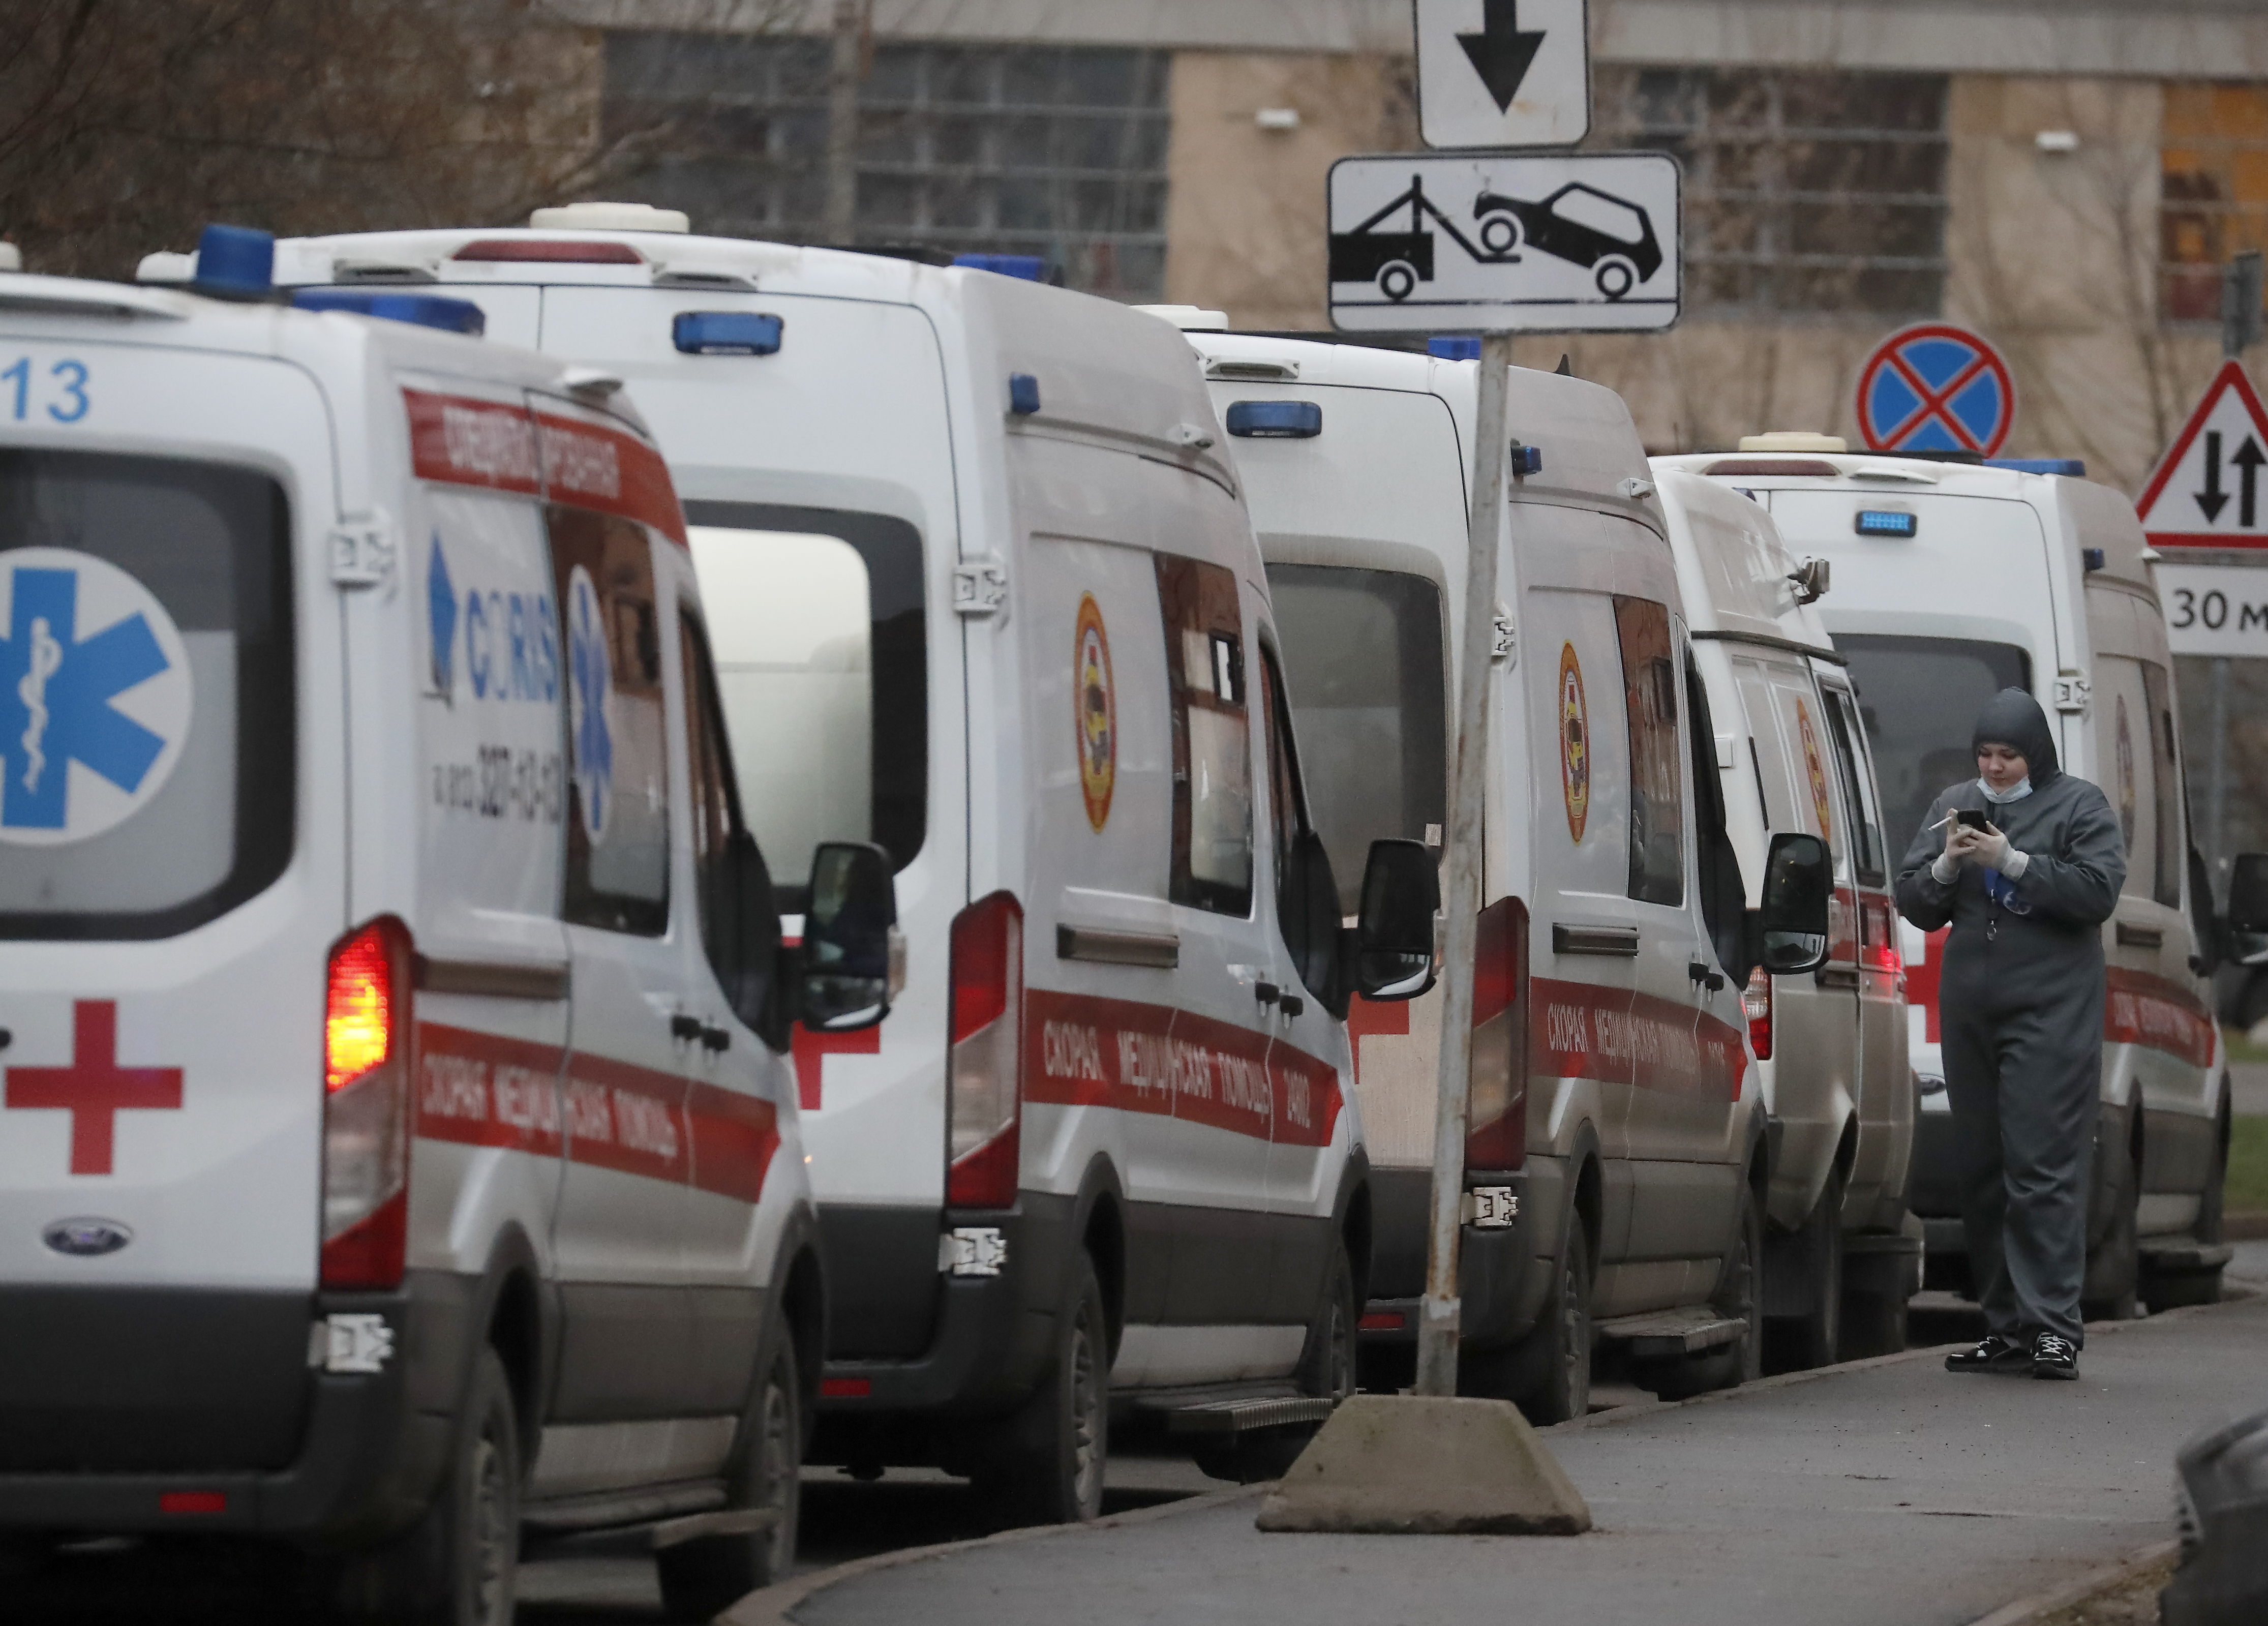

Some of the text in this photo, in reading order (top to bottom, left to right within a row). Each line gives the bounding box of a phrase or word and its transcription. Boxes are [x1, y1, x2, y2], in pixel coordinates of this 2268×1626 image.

[1, 357, 92, 424] 13
[2171, 587, 2228, 630] 30
[1043, 1019, 1104, 1081] СКОРАЯ
[1548, 1002, 1589, 1052] СКОРАЯ
